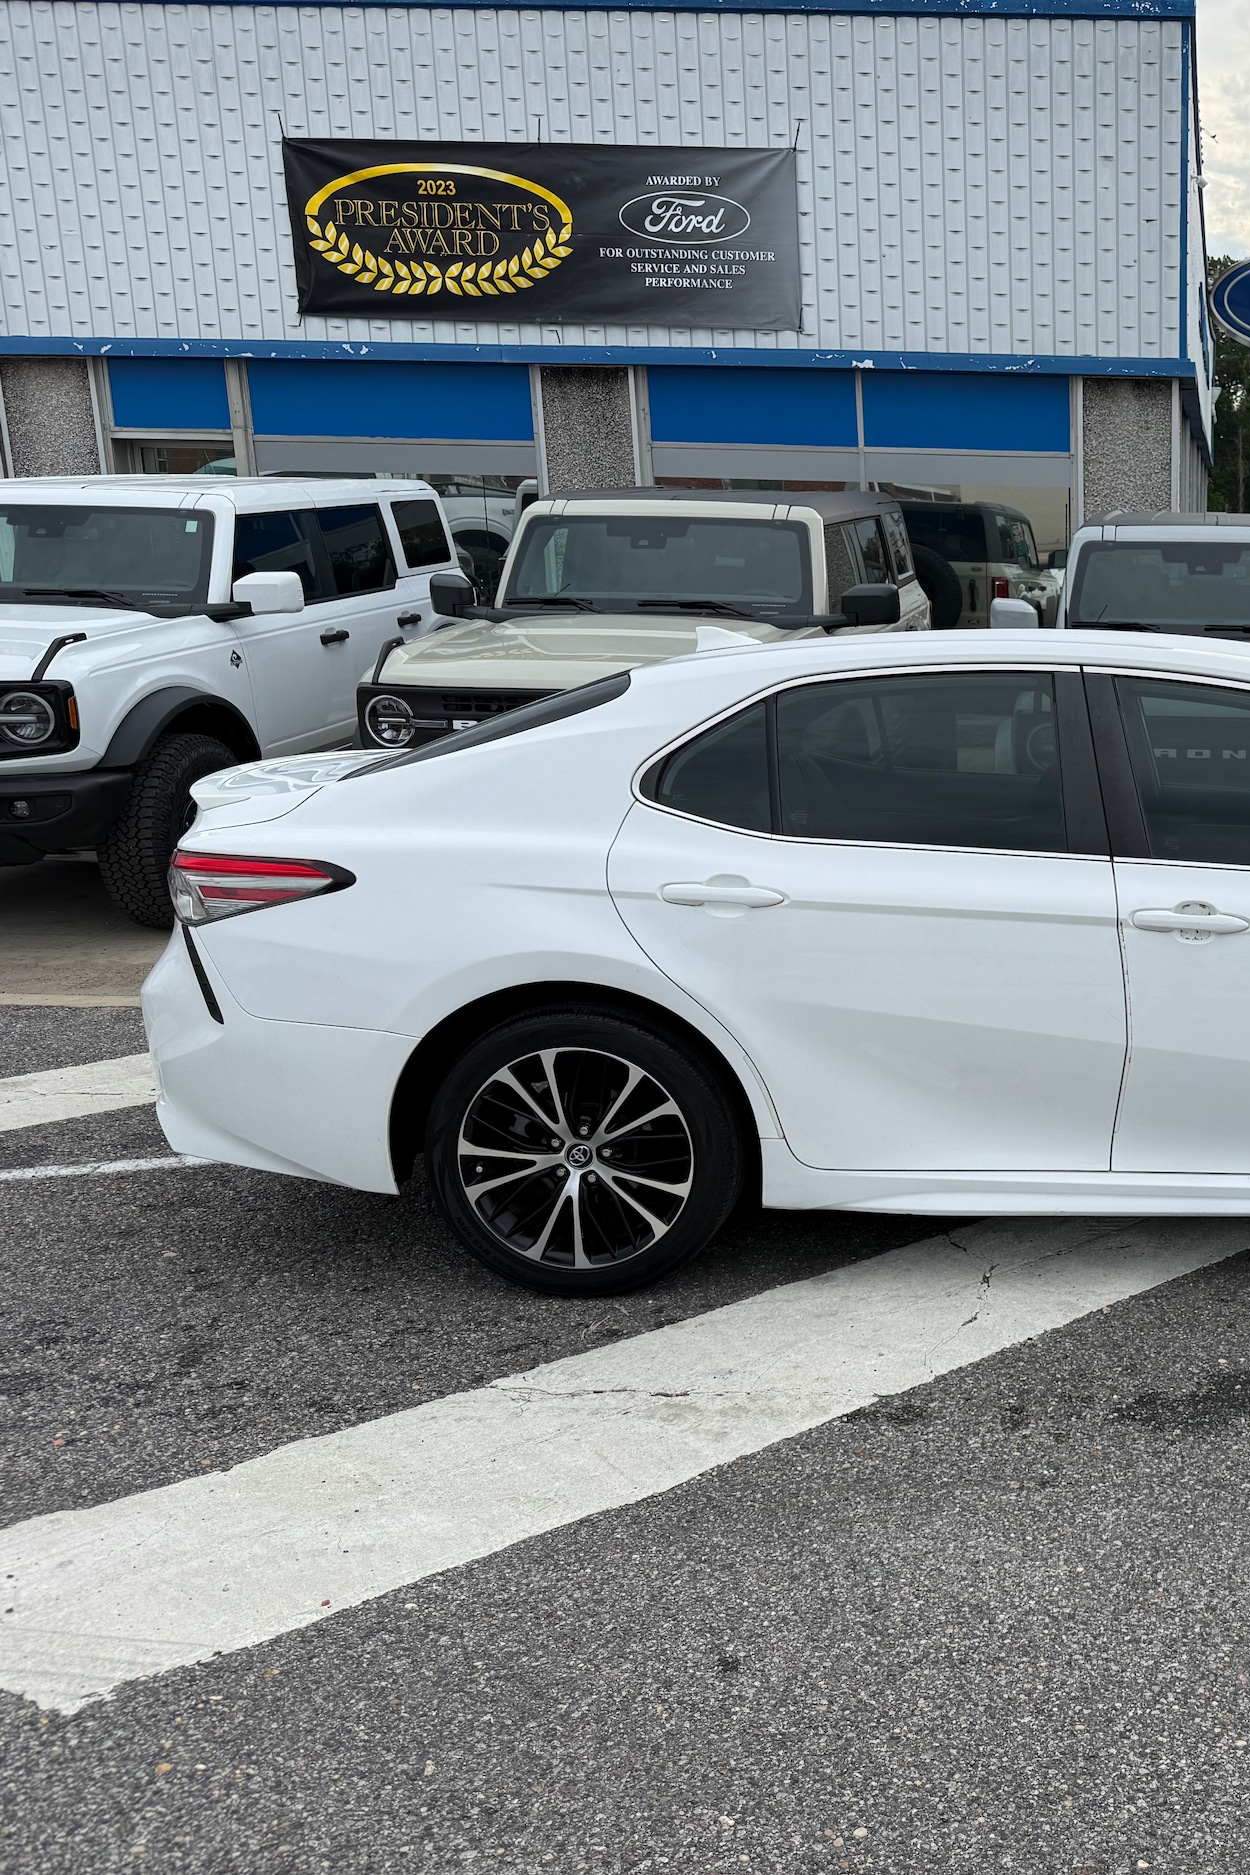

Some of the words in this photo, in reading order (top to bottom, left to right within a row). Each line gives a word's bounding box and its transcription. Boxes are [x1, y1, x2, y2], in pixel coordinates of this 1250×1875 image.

[416, 179, 457, 196] 2023
[646, 175, 702, 186] AWARDED
[705, 176, 721, 187] BY
[333, 199, 550, 232] PRESIDENT'S
[644, 197, 726, 234] Ford
[383, 228, 500, 257] AWARD
[599, 247, 624, 259] FOR
[626, 248, 709, 260] OUTSTANDING
[711, 250, 776, 262] CUSTOMER
[630, 262, 681, 274] SERVICE
[683, 264, 707, 274] AND
[710, 264, 746, 275] SALES
[645, 277, 733, 289] PERFORMANCE
